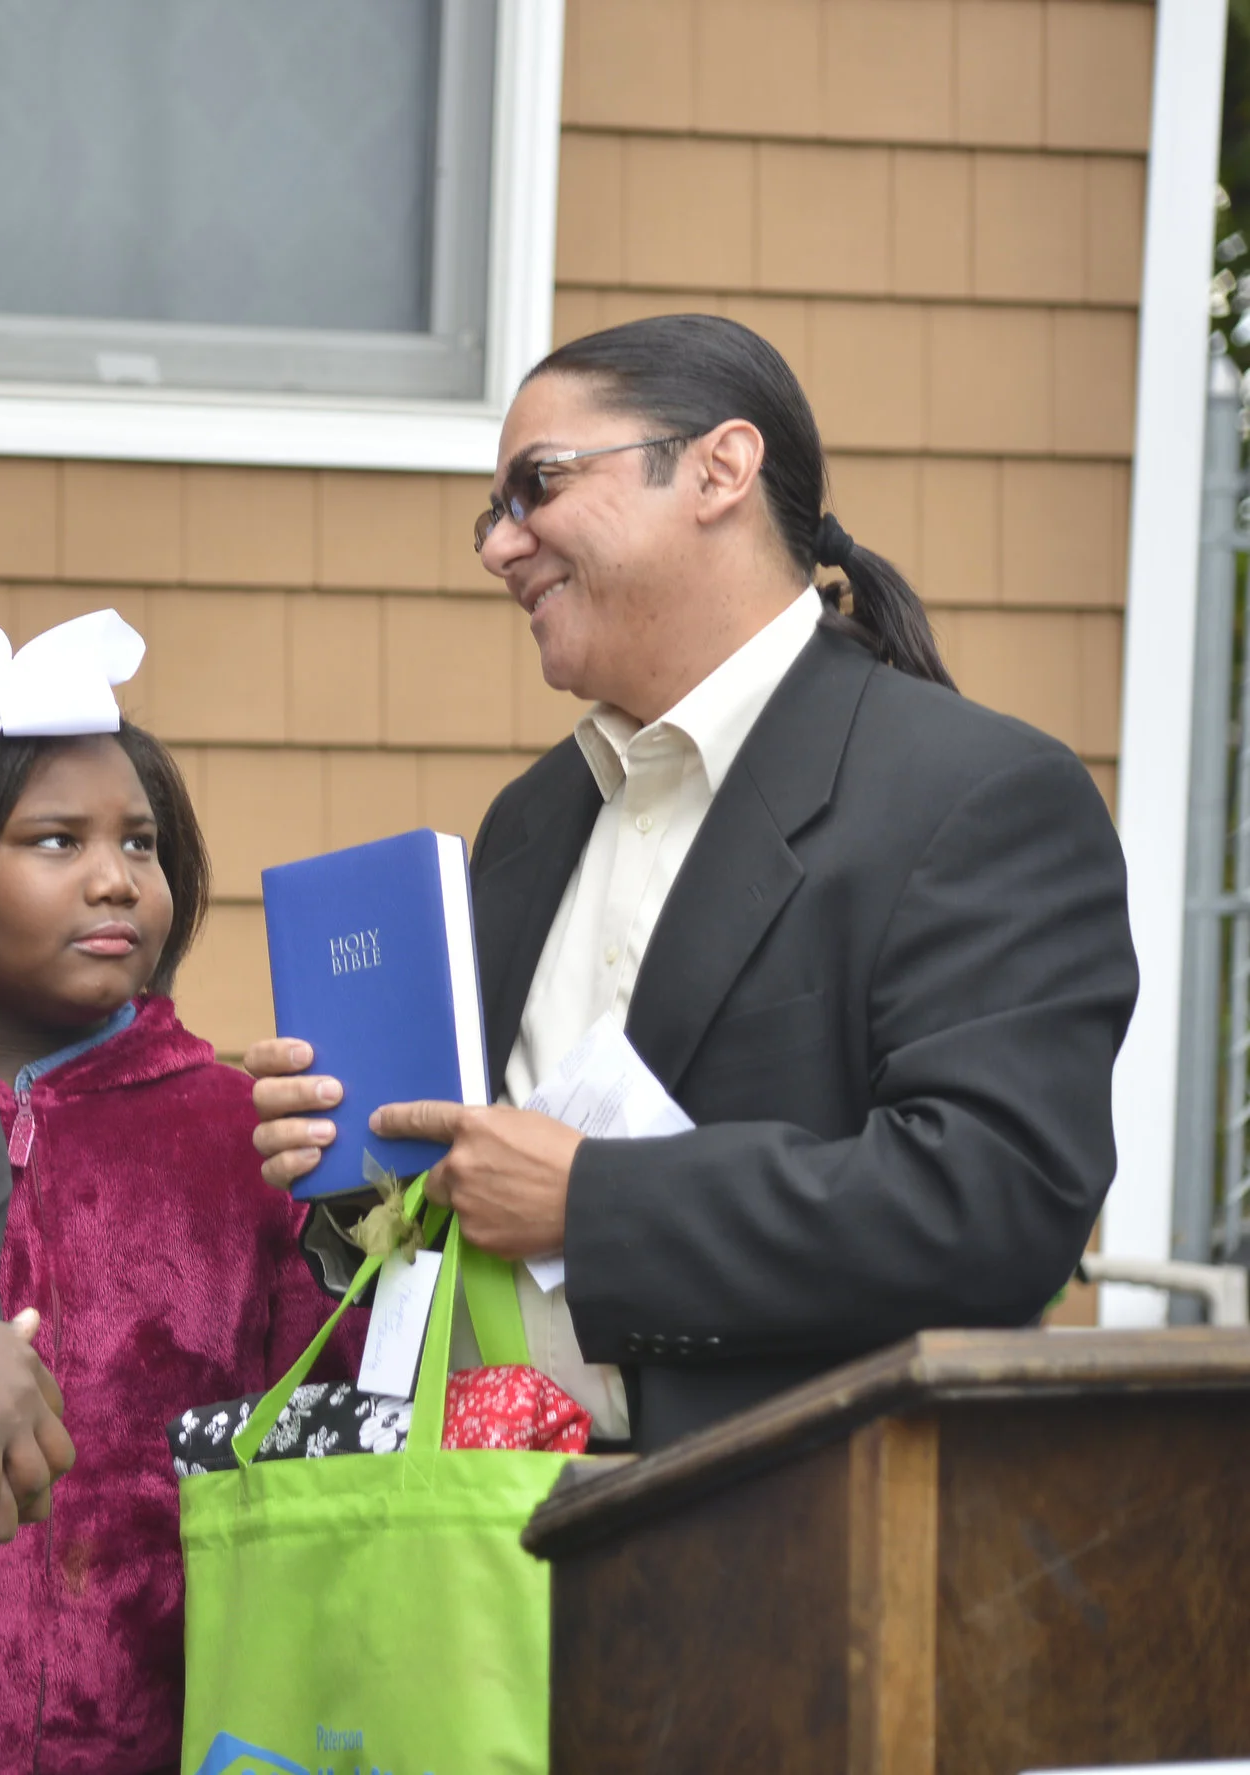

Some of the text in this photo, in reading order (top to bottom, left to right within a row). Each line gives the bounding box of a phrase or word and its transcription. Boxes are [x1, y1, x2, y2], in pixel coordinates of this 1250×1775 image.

[330, 927, 379, 956] HOLY
[332, 947, 382, 976] BIBLE
[316, 1723, 363, 1751] Paterson
